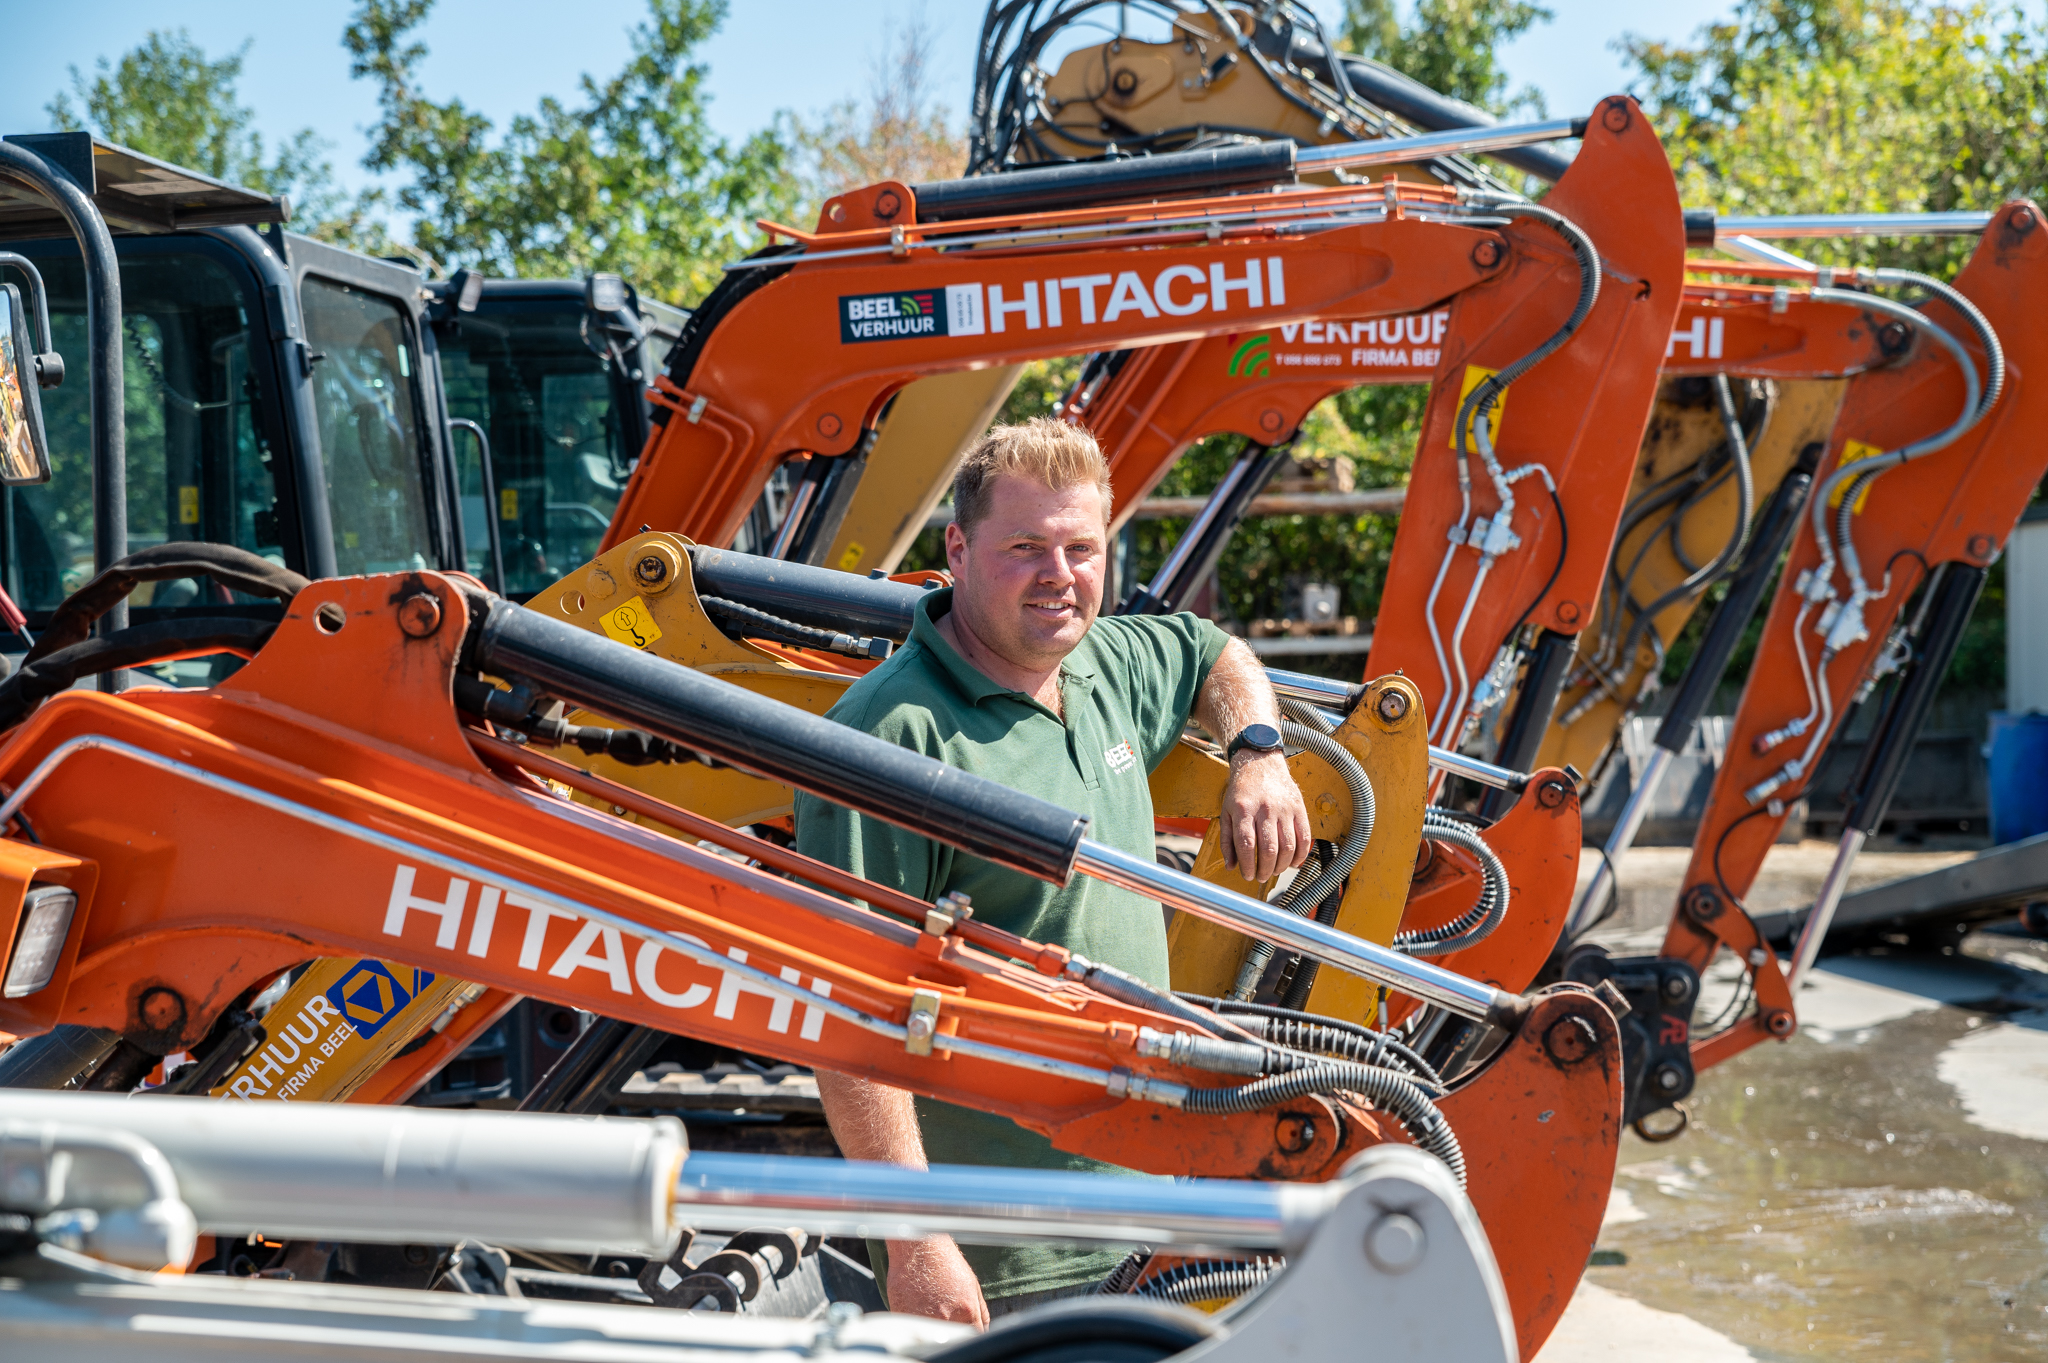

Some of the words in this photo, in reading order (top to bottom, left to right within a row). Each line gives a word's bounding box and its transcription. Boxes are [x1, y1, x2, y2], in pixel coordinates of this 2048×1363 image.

[847, 297, 901, 321] BEEL
[987, 256, 1286, 334] HITACHI
[849, 316, 935, 339] VERHUUR
[1351, 347, 1409, 367] FIRMA
[382, 863, 832, 1042] HITACHI
[276, 1056, 325, 1103] FIRMA
[319, 1021, 359, 1058] BEEL
